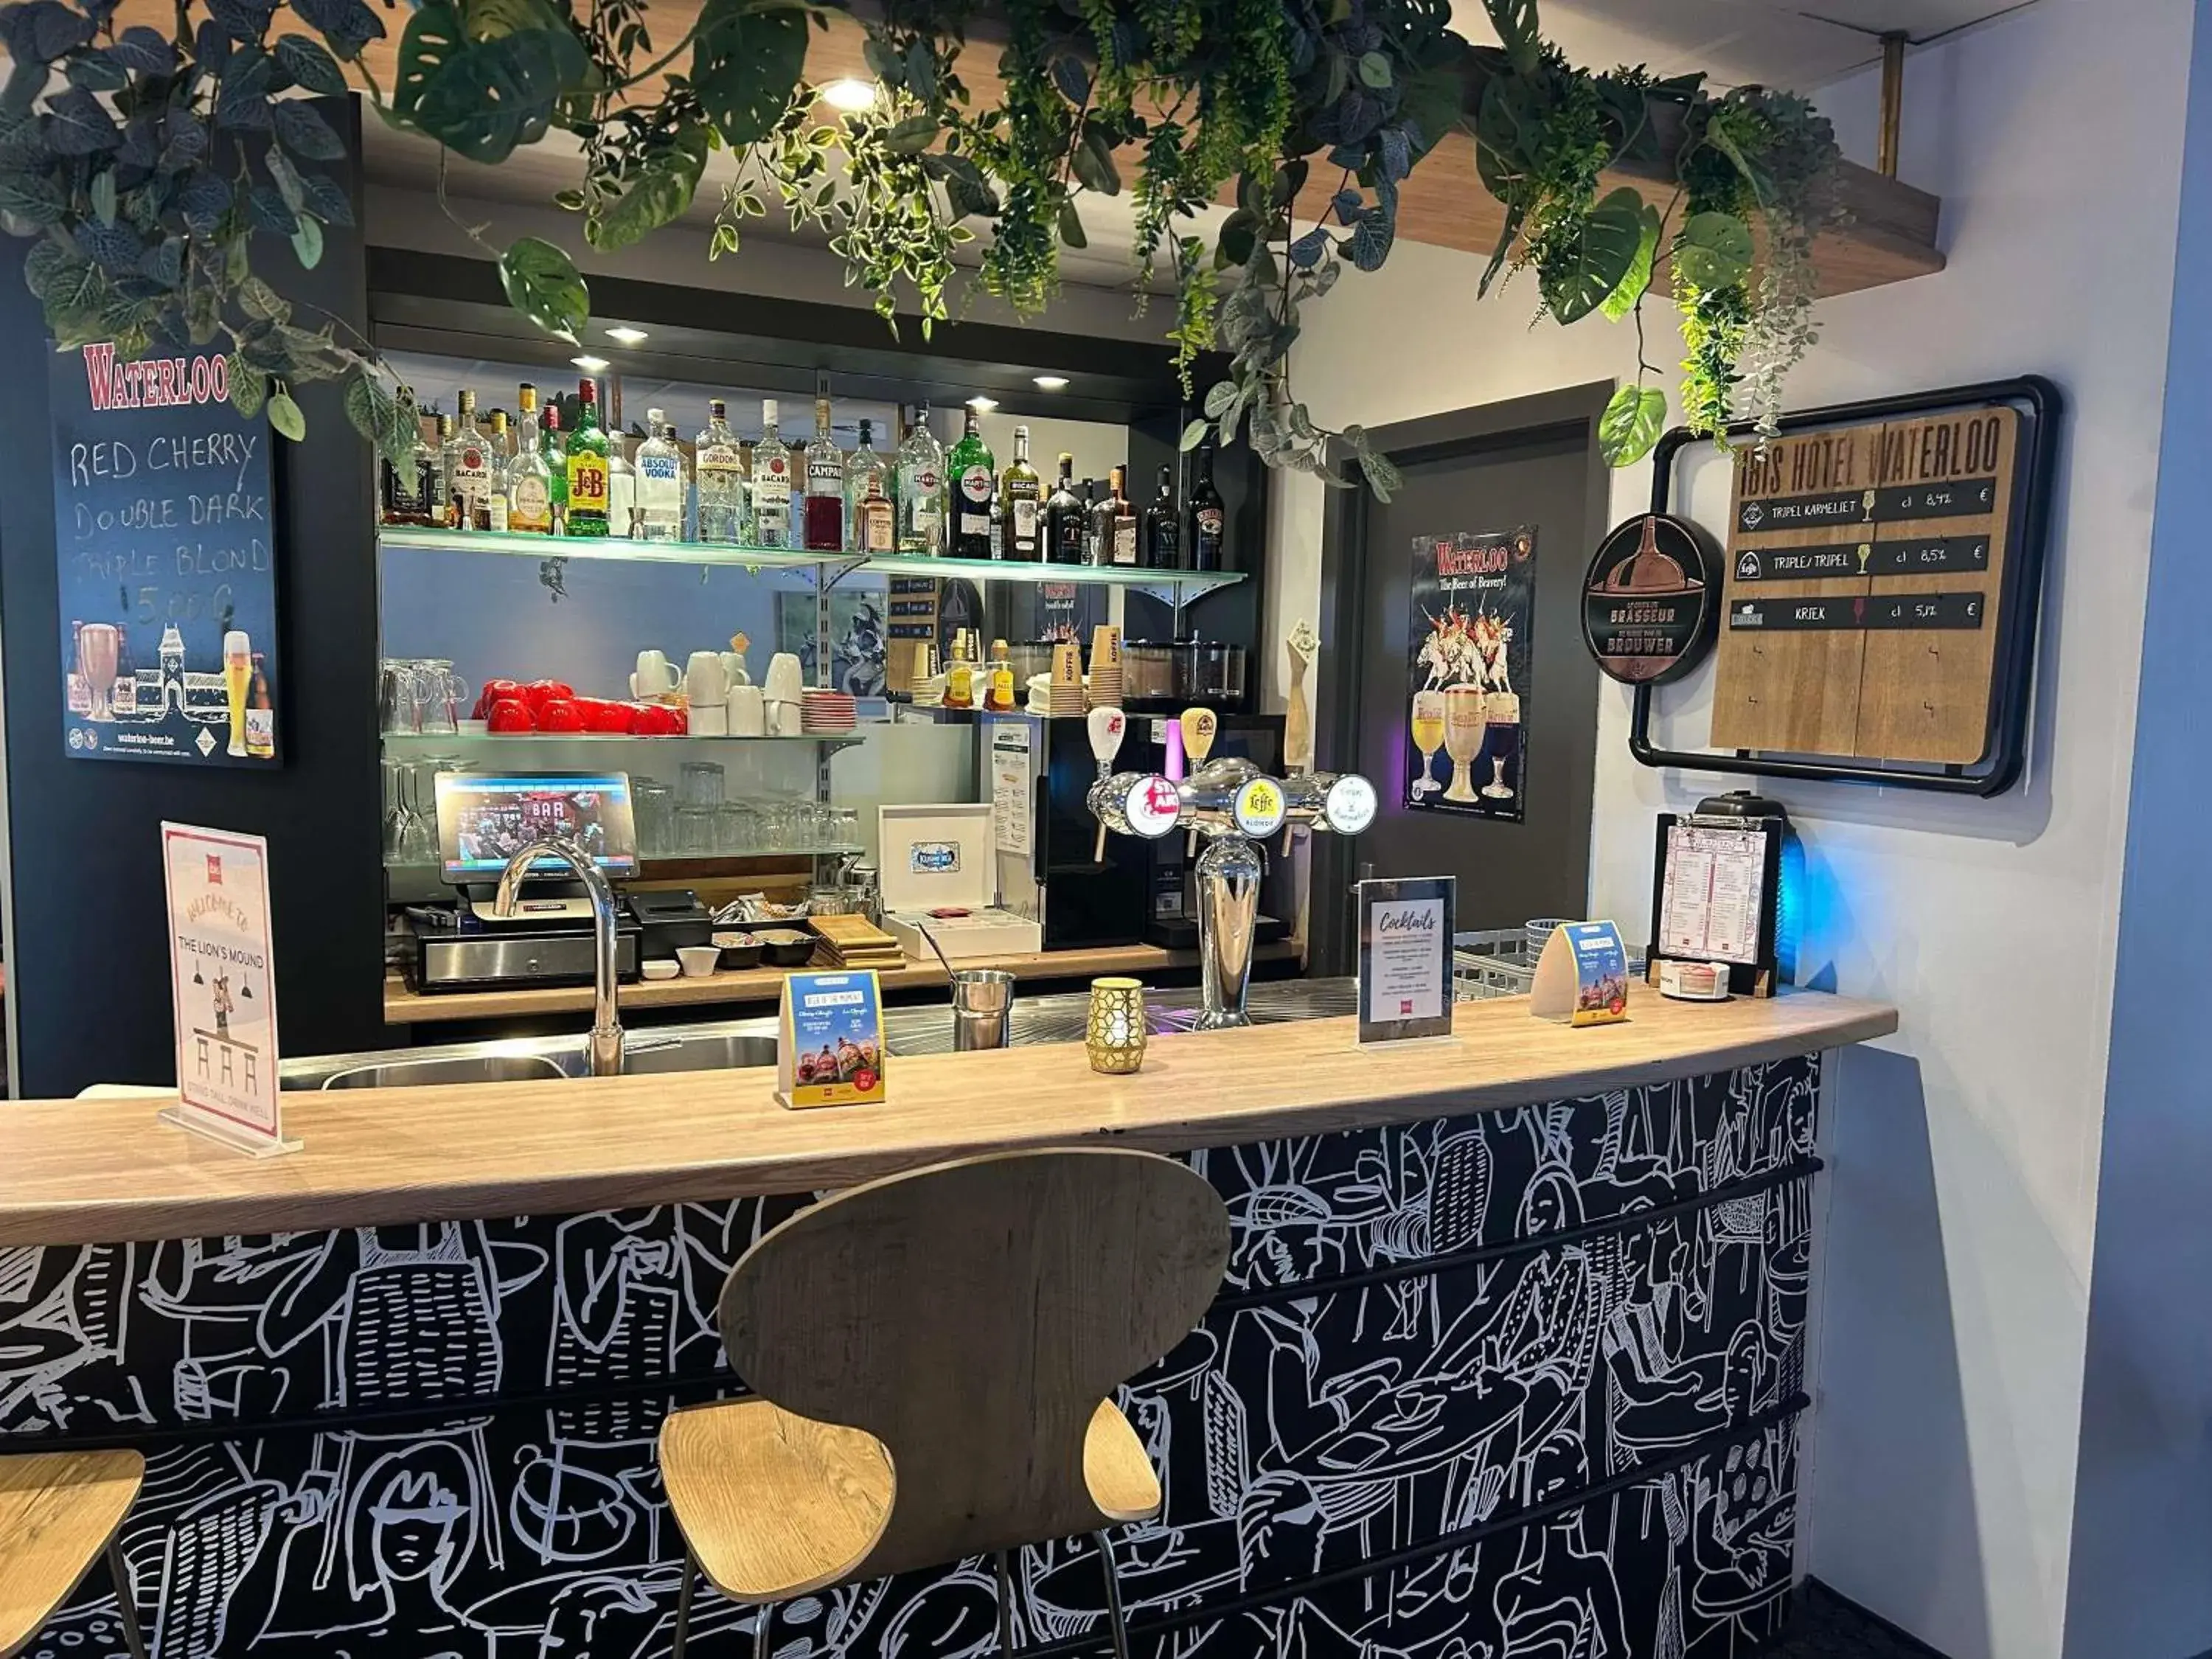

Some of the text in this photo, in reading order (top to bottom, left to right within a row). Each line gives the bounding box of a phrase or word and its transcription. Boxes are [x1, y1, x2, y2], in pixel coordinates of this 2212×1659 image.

[83, 341, 229, 411] WATERLOO
[71, 433, 257, 493] RED CHERRY
[1791, 436, 1855, 492] HOTEL
[1869, 417, 2001, 483] WATERLOO
[645, 468, 676, 479] VODKA
[74, 493, 265, 540] DOUBLE DARK
[1772, 505, 1801, 518] TRIPEL
[1804, 501, 1857, 515] KARMELIET
[1980, 487, 1989, 501] €
[176, 538, 269, 575] BLOND
[1815, 554, 1849, 568] TRIPEL
[1974, 545, 1983, 559] €
[1469, 576, 1478, 588] of
[1478, 575, 1507, 591] Bravery!
[1610, 608, 1675, 624] BRASSEUR
[1795, 607, 1826, 620] KRIEK
[1967, 602, 1977, 616] €
[1607, 637, 1674, 654] BROUWER
[1065, 650, 1074, 683] KOFFIE
[532, 801, 564, 818] BAR
[1379, 907, 1437, 933] Cocktails
[178, 935, 264, 969] THE LION'S MOUND
